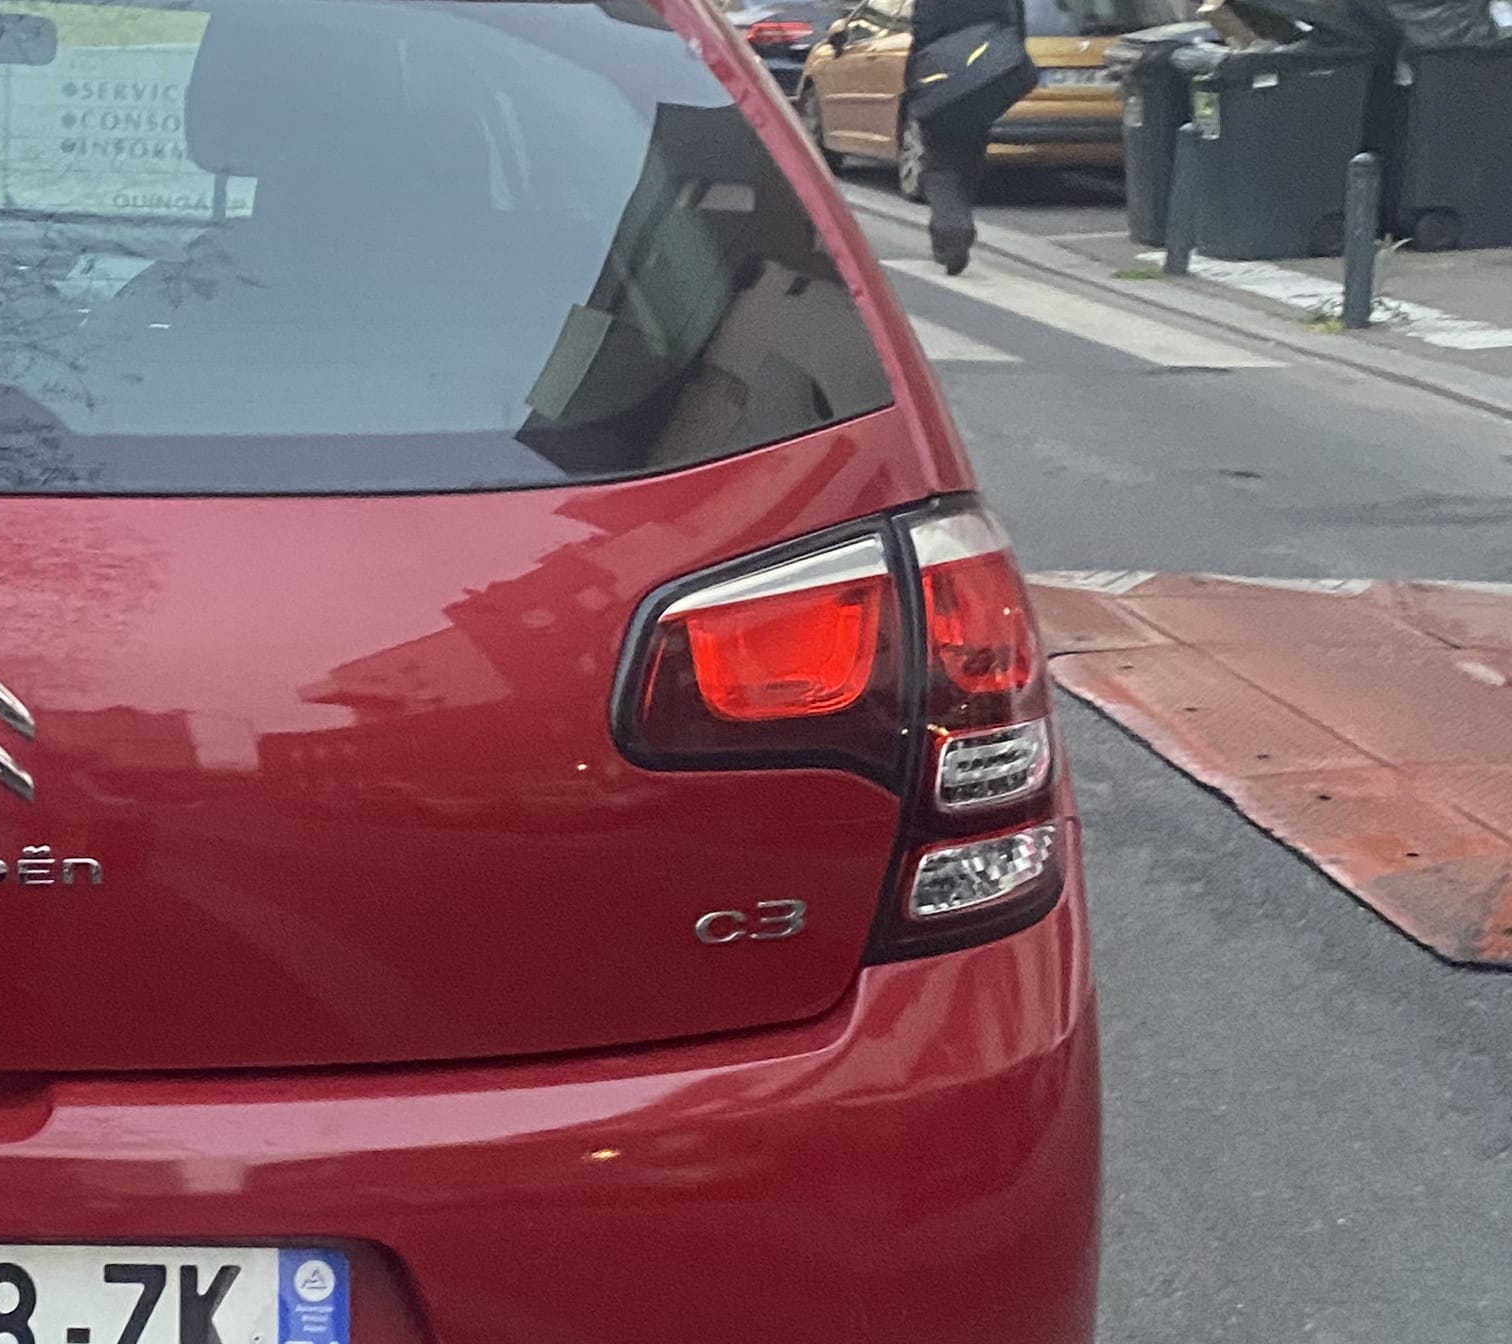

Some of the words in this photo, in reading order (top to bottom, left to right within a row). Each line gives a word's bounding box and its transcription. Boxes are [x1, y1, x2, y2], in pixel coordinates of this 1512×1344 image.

[81, 82, 179, 103] SERVIC
[80, 111, 182, 133] CONSO
[695, 899, 807, 944] C3
